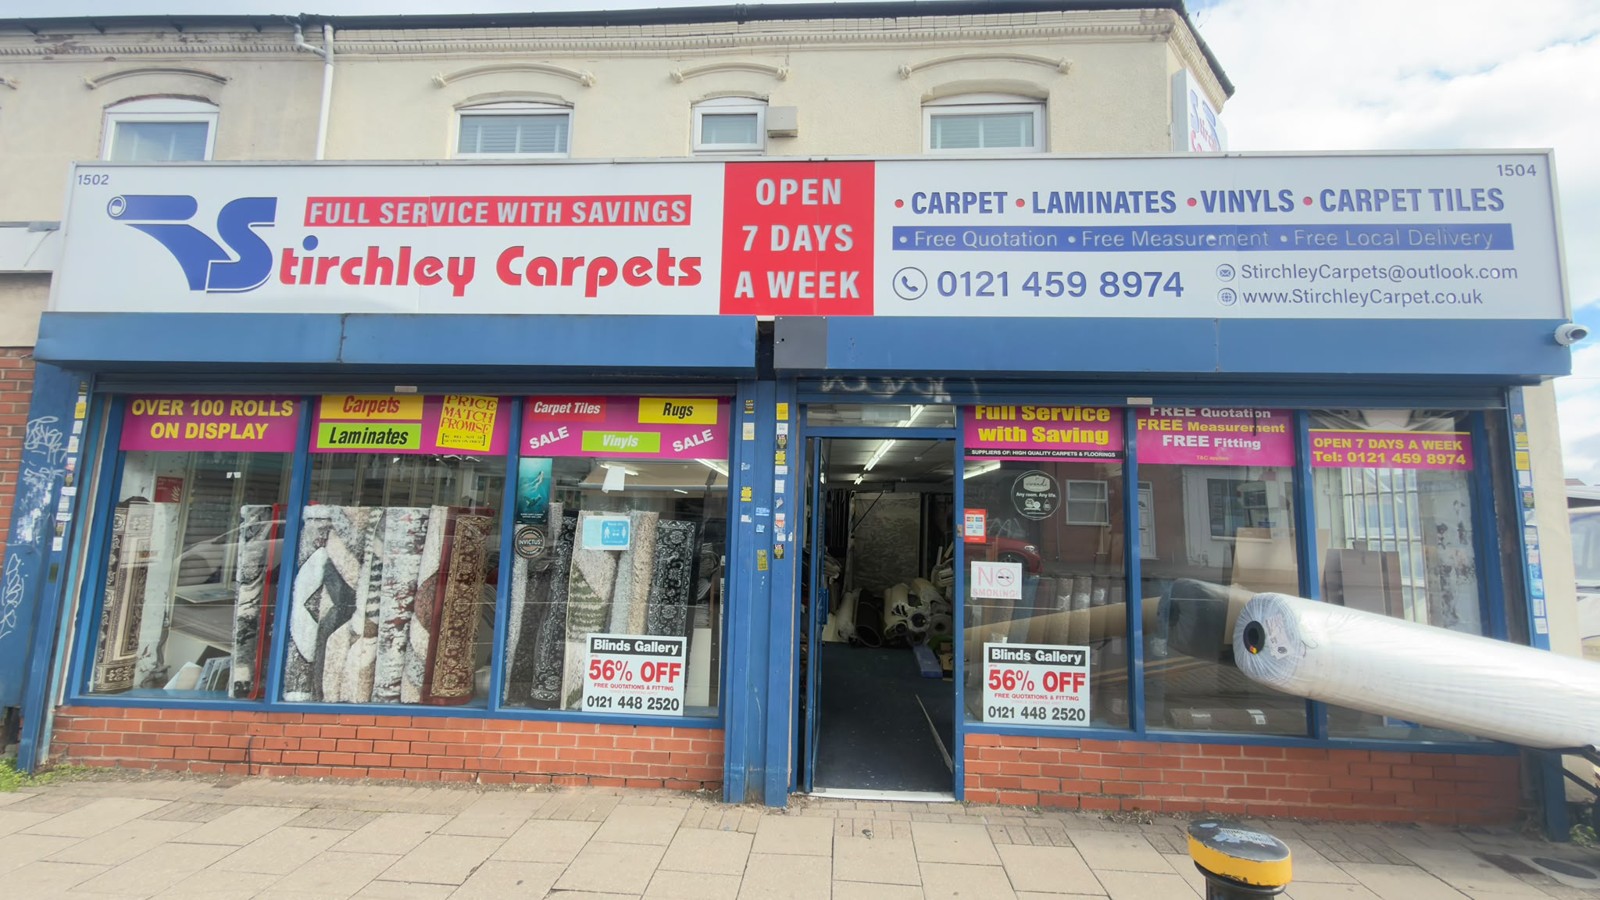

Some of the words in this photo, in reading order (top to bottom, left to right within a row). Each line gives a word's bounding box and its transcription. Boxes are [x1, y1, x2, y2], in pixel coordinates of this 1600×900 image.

[1497, 164, 1537, 177] 1504
[77, 174, 109, 186] 1502
[755, 178, 842, 206] OPEN
[911, 191, 1008, 215] CARPET
[1032, 190, 1177, 214] LAMINATES
[1200, 189, 1295, 213] VINYLS
[1319, 188, 1422, 212] CARPET
[1429, 187, 1505, 212] TILES
[309, 202, 370, 224] FULL
[379, 201, 489, 224] SERVICE
[498, 201, 562, 223] WITH
[571, 200, 687, 223] SAVINGS
[742, 225, 758, 252] 7
[770, 224, 854, 252] DAYS
[915, 231, 956, 247] Free
[962, 230, 1057, 248] Quotation
[1082, 231, 1125, 247] Free
[1132, 230, 1268, 247] Measurement
[1294, 230, 1338, 246] Free
[1345, 229, 1400, 246] Local
[1408, 229, 1493, 249] Delivery
[496, 245, 702, 298] Carpets
[1241, 264, 1518, 283] StirchleyCarpets@outlook.com
[734, 271, 752, 298] A
[767, 271, 860, 299] WEEK
[937, 271, 1009, 297] 0121
[1022, 271, 1087, 297] 459
[1099, 271, 1184, 298] 8974
[1242, 288, 1483, 307] www.StirchleyCarpet.co.uk
[132, 399, 184, 416] OVER
[190, 399, 224, 417] 100
[230, 399, 294, 417] ROLLS
[343, 395, 400, 417] Carpets
[446, 395, 497, 411] PRICE
[534, 401, 571, 416] Carpet
[574, 402, 601, 414] Tiles
[662, 402, 694, 419] Rugs
[444, 406, 494, 423] MATCH
[975, 405, 1016, 420] Full
[1021, 405, 1111, 422] Service
[1150, 407, 1196, 417] FREE
[1201, 407, 1271, 418] Quotation
[150, 422, 180, 439] ON
[185, 423, 269, 439] DISPLAY
[440, 417, 491, 434] PROMISE
[1137, 419, 1183, 431] FREE
[1187, 421, 1286, 433] Measurement
[329, 427, 409, 445] Laminates
[529, 426, 570, 450] SALE
[602, 434, 639, 449] Vinyls
[672, 429, 714, 453] SALE
[978, 426, 1027, 442] with
[1032, 426, 1109, 445] Saving
[1162, 435, 1210, 447] FREE
[1214, 437, 1261, 451] Fitting
[1313, 438, 1352, 448] OPEN
[1356, 439, 1364, 449] 7
[1368, 439, 1405, 449] DAYS
[1408, 440, 1419, 450] A
[1422, 440, 1464, 451] WEEK
[1313, 451, 1342, 463] Tel:
[1347, 452, 1386, 464] 0121
[1391, 453, 1422, 465] 459
[1426, 454, 1467, 466] 8974
[973, 588, 1017, 598] SMOKING
[593, 639, 631, 652] Blinds
[634, 640, 679, 655] Gallery
[991, 648, 1031, 661] Blinds
[1035, 650, 1082, 665] Gallery
[588, 659, 633, 681] 56%
[640, 661, 682, 683] OFF
[988, 669, 1035, 691] 56%
[1042, 671, 1086, 693] OFF
[587, 695, 612, 708] 0121
[618, 696, 643, 709] 448
[647, 697, 680, 711] 2520
[988, 706, 1015, 719] 0121
[1020, 706, 1047, 720] 448
[1052, 707, 1086, 722] 2520
